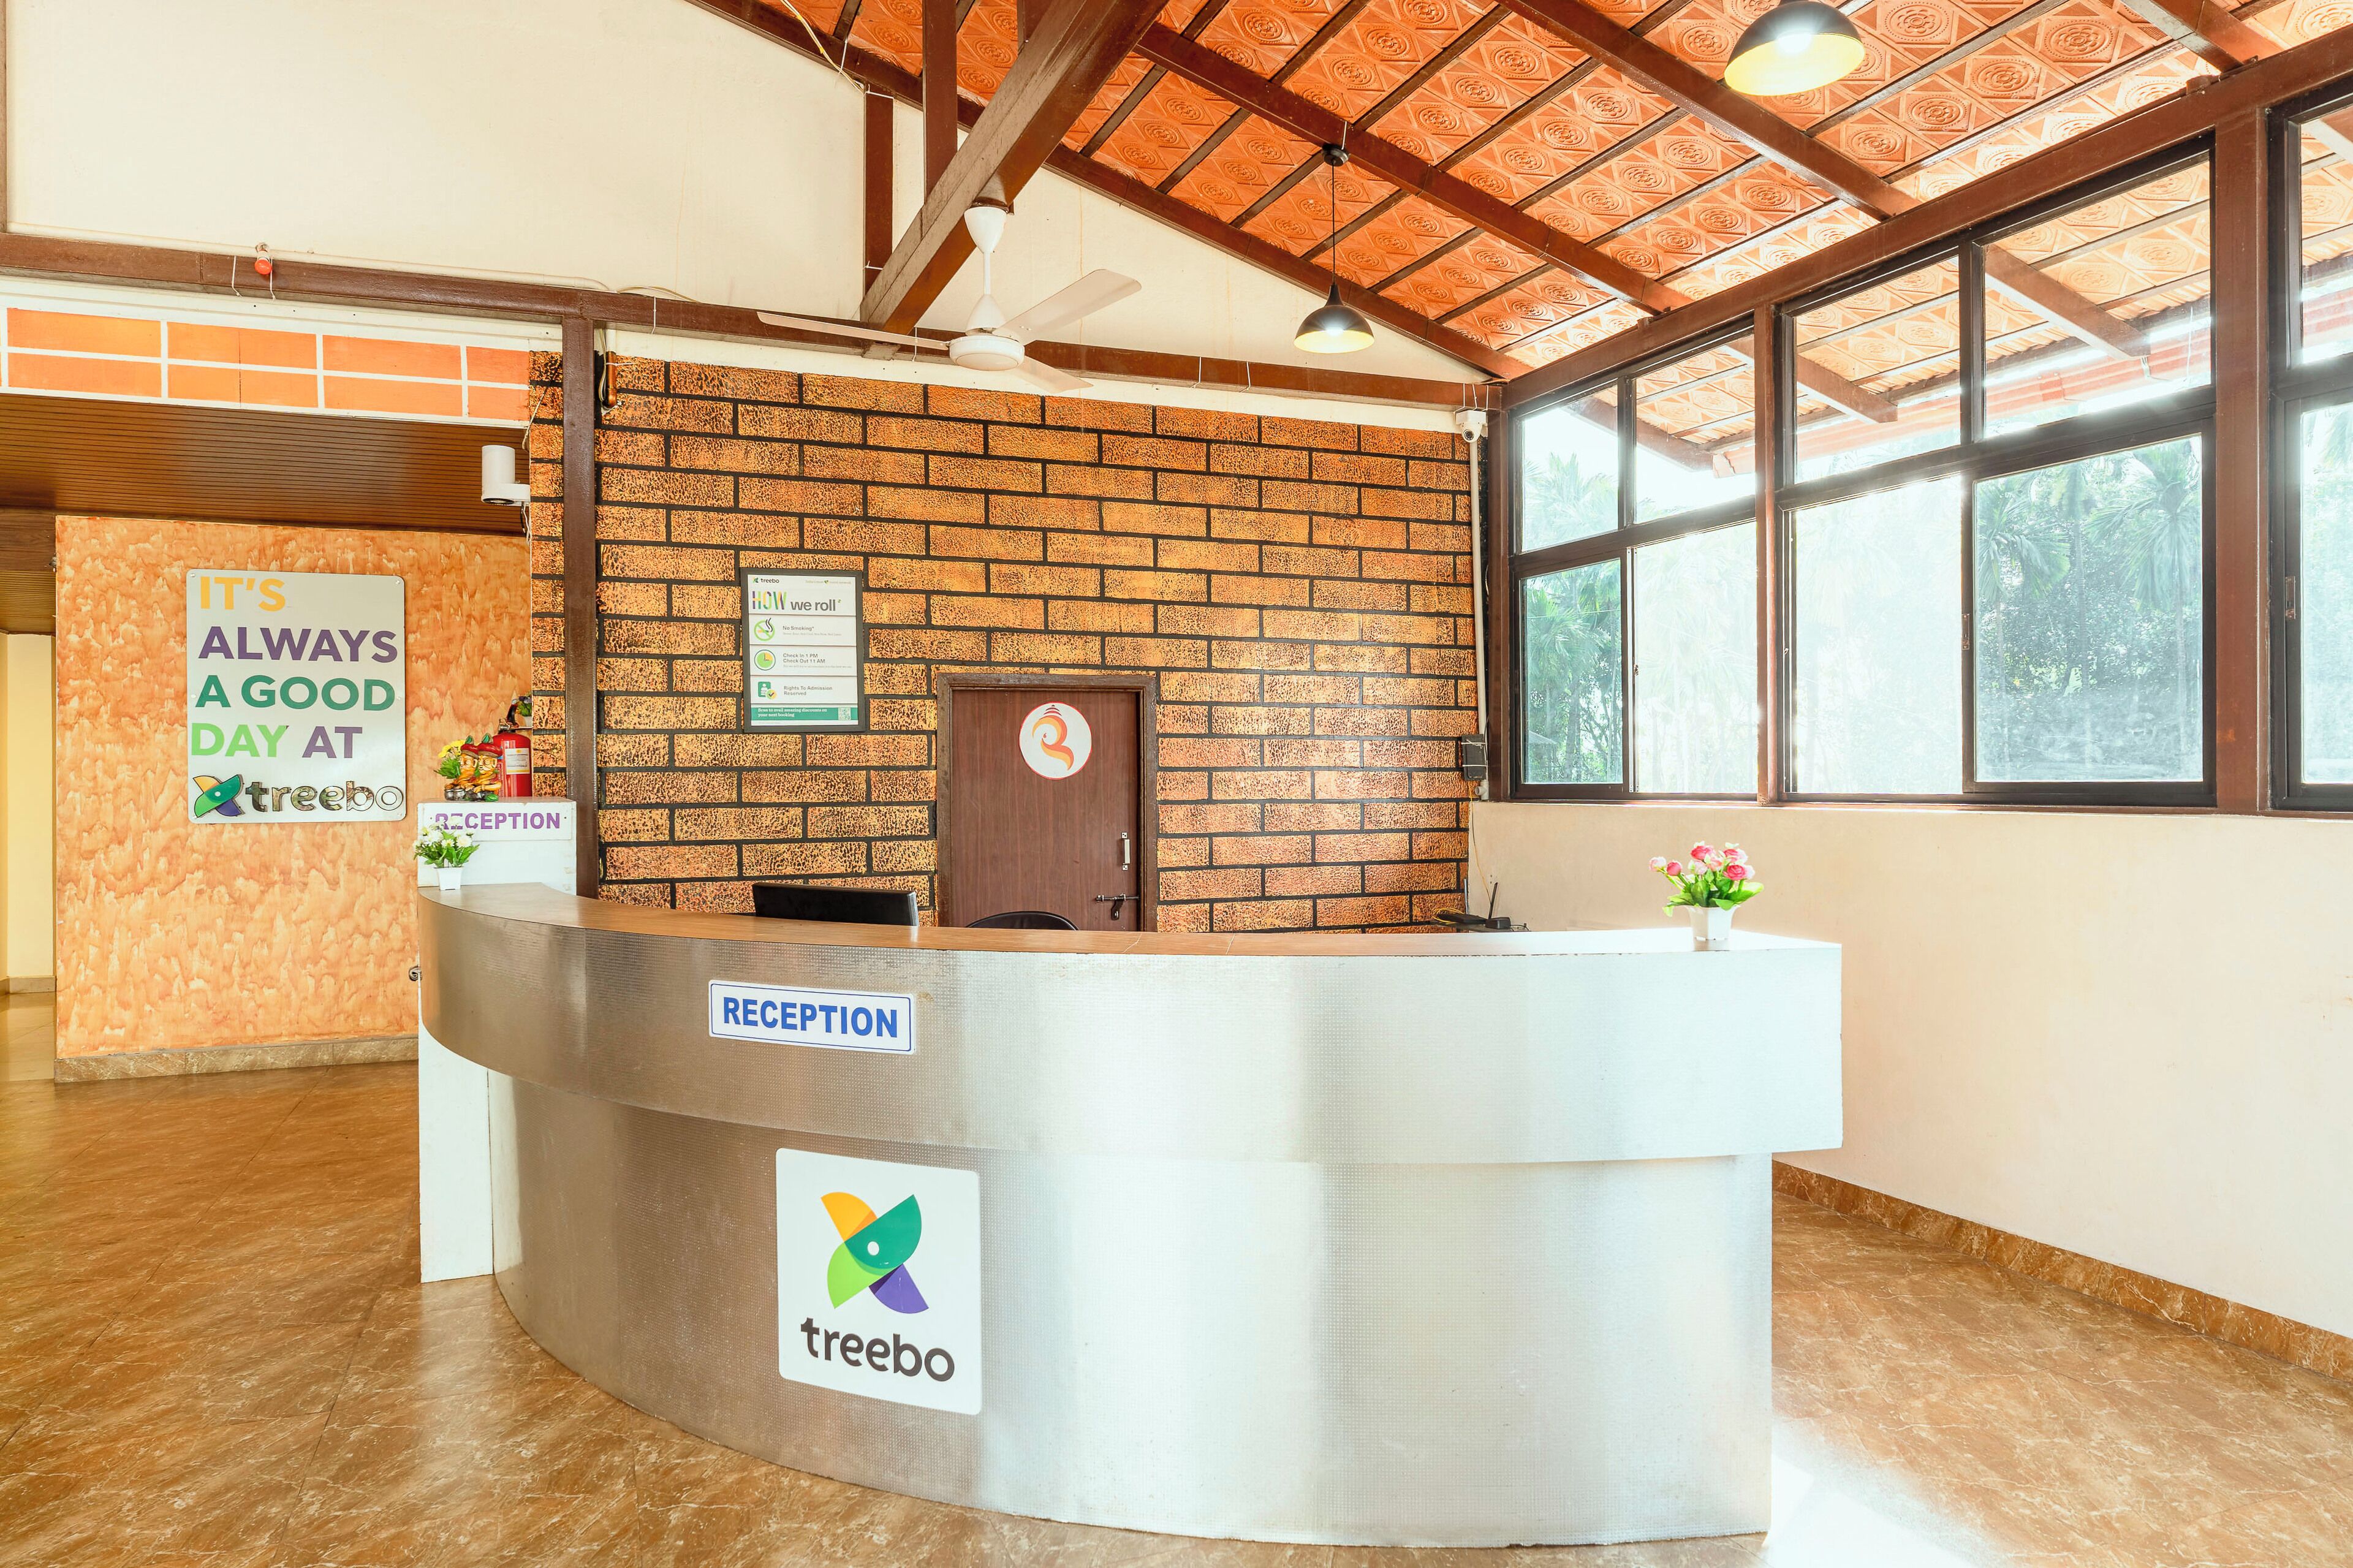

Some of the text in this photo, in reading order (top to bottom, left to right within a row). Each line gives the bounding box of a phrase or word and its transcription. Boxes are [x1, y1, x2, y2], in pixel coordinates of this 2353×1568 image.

[200, 576, 286, 612] IT'S
[752, 591, 836, 612] HOW we roll
[198, 626, 398, 663] ALWAYS
[195, 675, 396, 711] A GOOD
[191, 722, 363, 759] DAY AT
[245, 781, 404, 812] treebo
[723, 996, 898, 1038] RECEPTION
[800, 1317, 955, 1382] treebo
